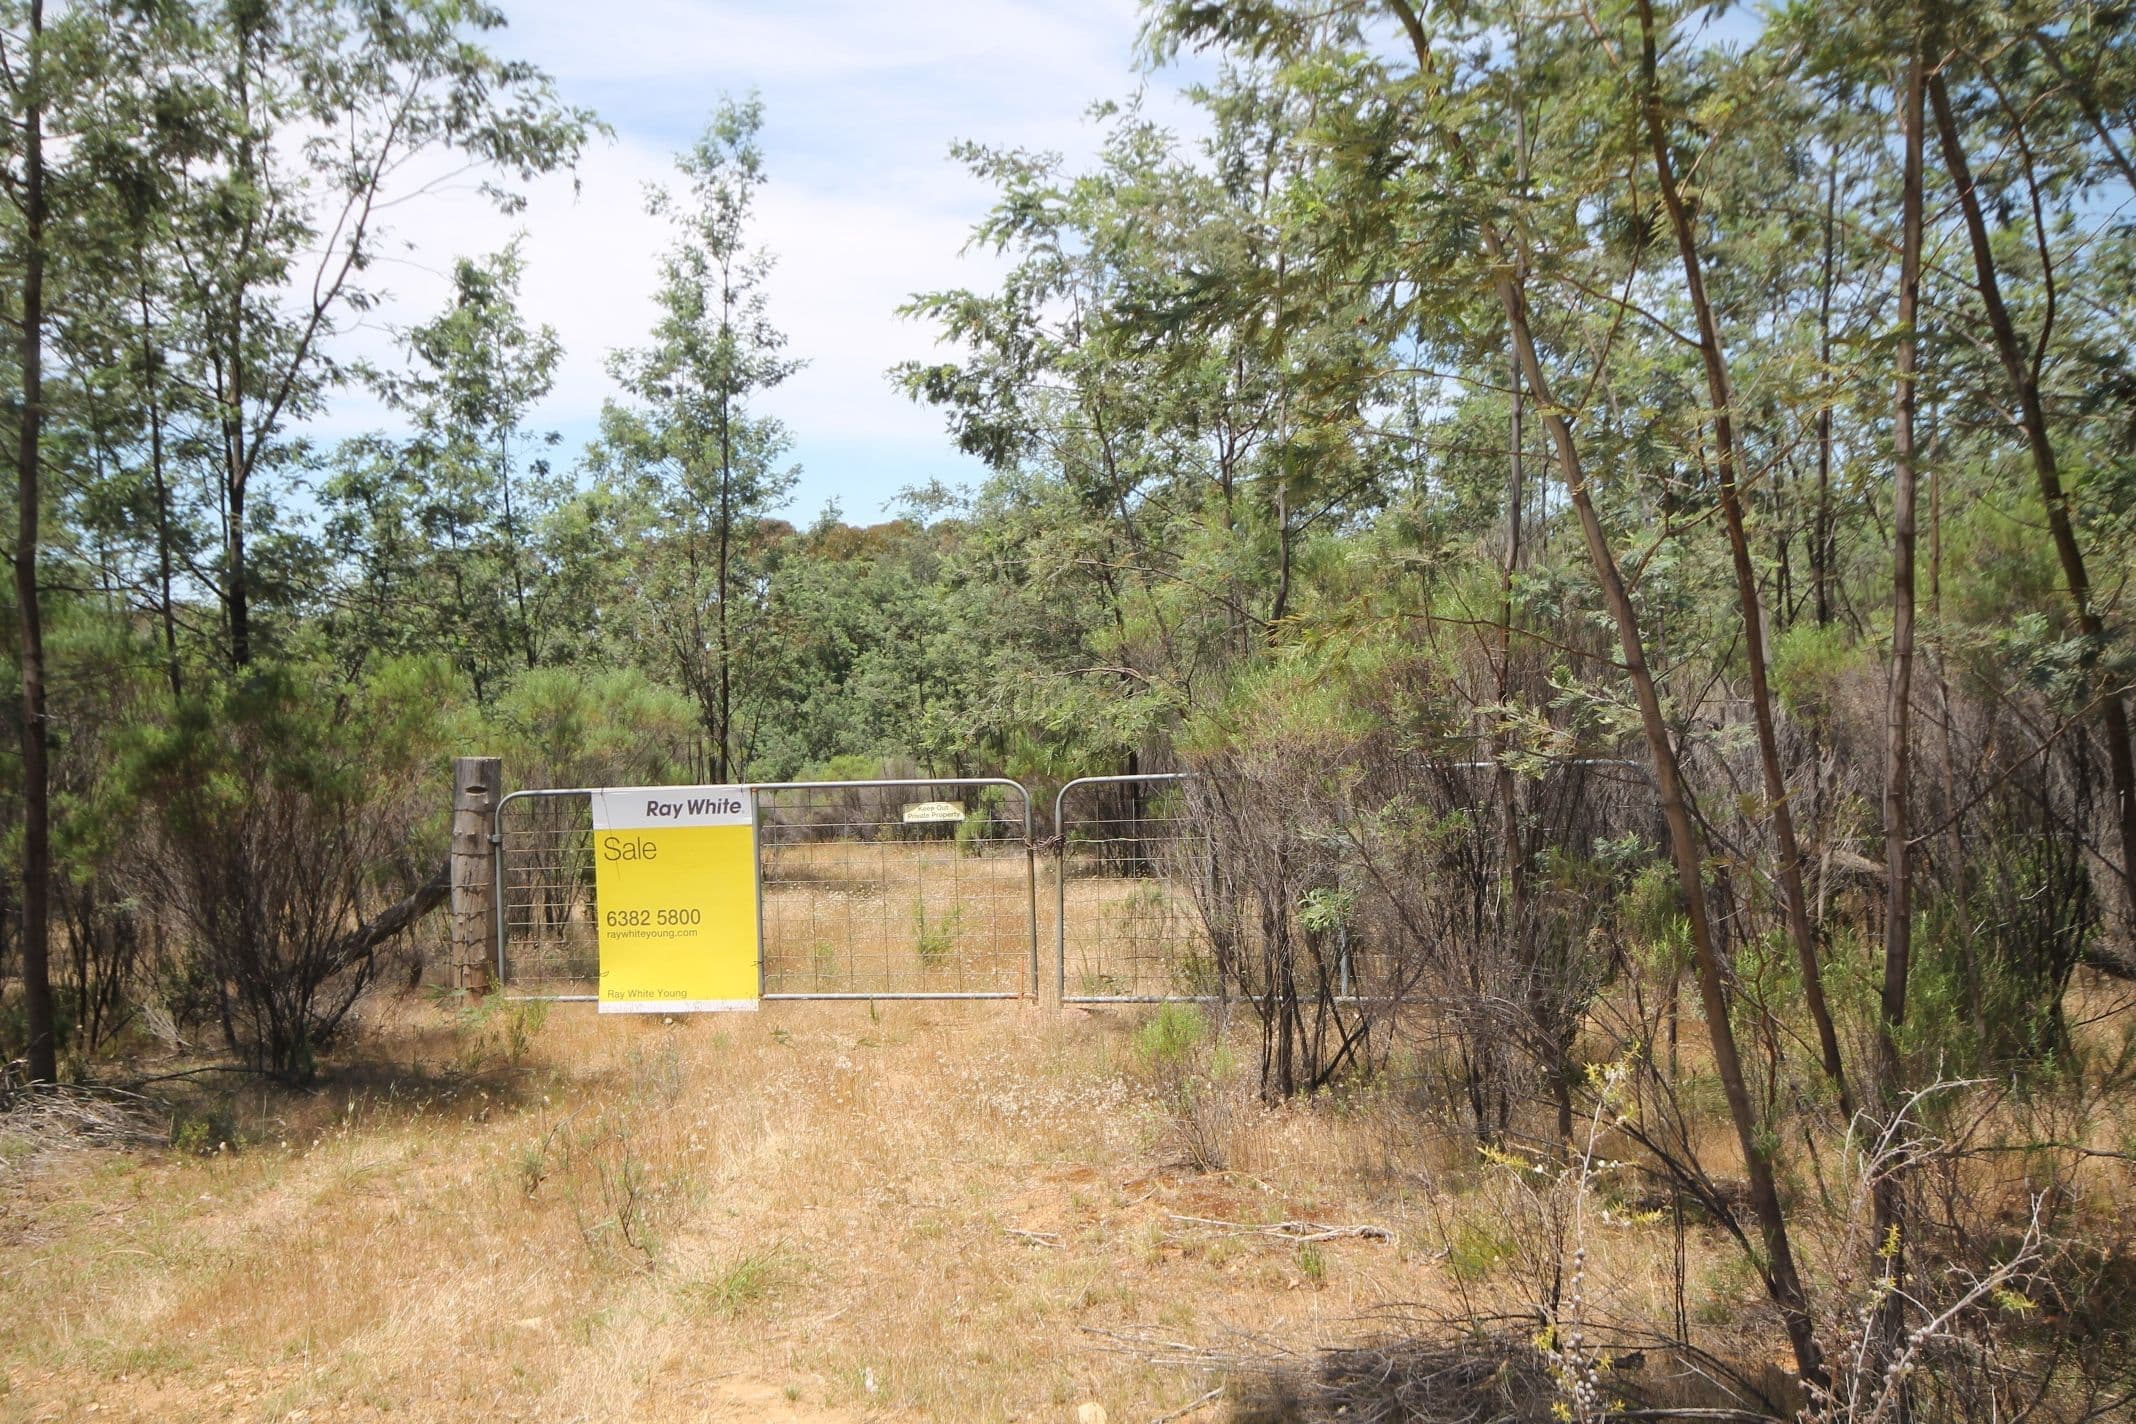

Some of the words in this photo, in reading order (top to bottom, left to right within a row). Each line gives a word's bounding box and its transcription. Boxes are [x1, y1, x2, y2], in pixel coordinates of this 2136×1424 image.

[646, 800, 683, 819] Ray
[687, 798, 742, 815] White
[604, 836, 657, 862] Sale
[606, 909, 651, 927] 6382
[656, 908, 701, 926] 5800
[607, 928, 698, 940] raywhiteyoung.com
[607, 989, 626, 1000] Ray
[628, 988, 655, 998] White
[657, 988, 688, 999] Young
